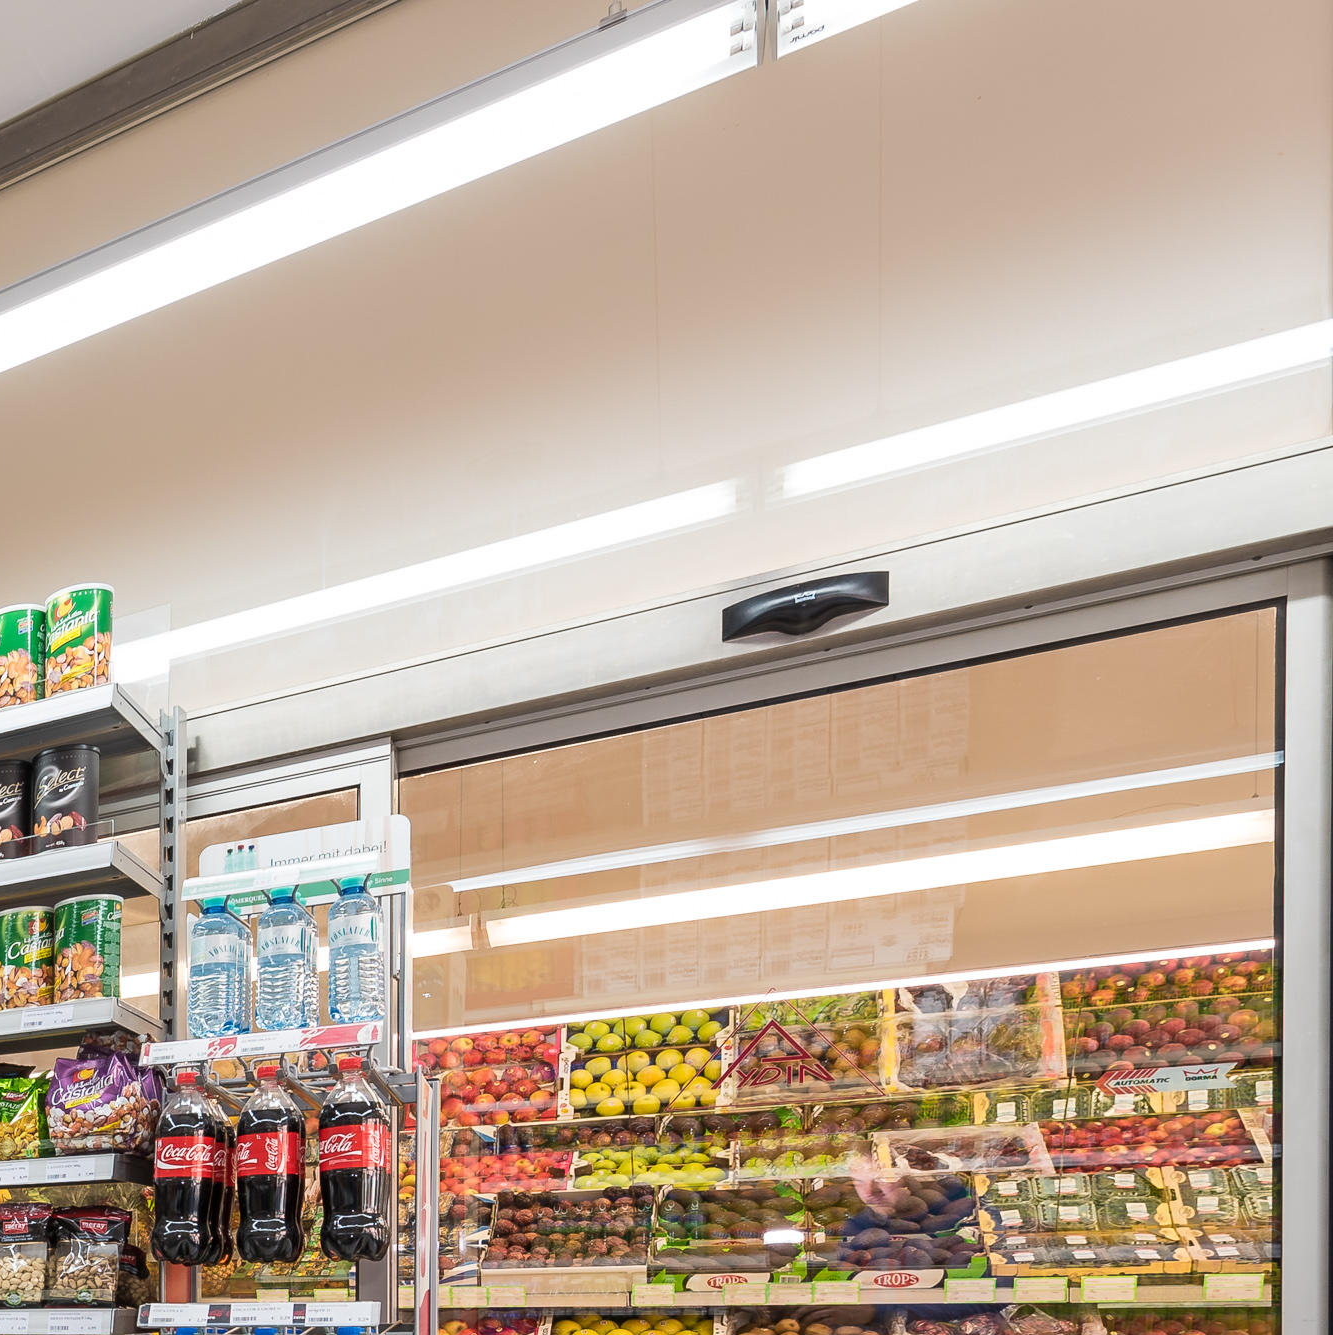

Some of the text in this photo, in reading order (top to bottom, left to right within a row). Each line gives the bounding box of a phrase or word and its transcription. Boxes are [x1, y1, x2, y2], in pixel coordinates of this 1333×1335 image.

[36, 766, 85, 807] Select
[270, 856, 313, 868] Immer
[319, 848, 340, 861] mit
[1113, 1076, 1170, 1088] AUTOMATIC
[1185, 1073, 1219, 1082] DORMA
[161, 1142, 213, 1162] Coca-Cola
[5, 1222, 26, 1231] meray
[82, 1221, 105, 1231] meray
[707, 1275, 748, 1288] TROPS
[874, 1273, 918, 1286] TROPS
